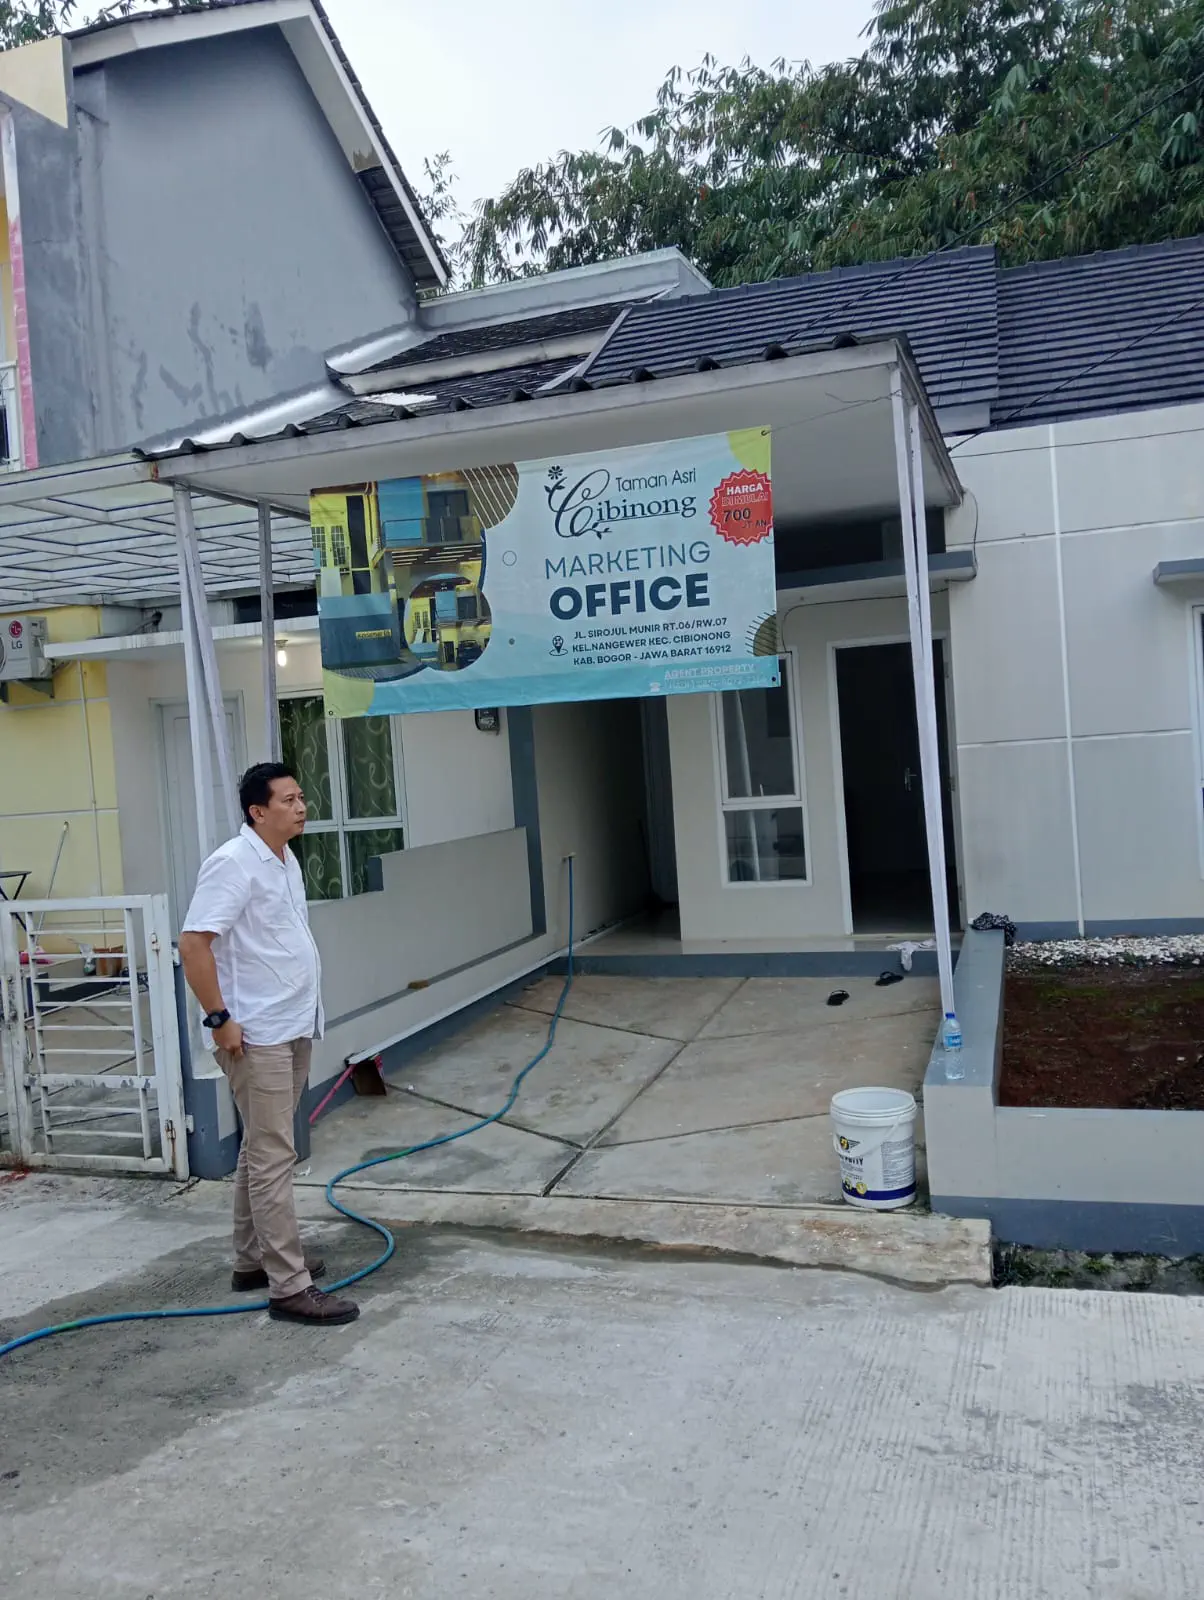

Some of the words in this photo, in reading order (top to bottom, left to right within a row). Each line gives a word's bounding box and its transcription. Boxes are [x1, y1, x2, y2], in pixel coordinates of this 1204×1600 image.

[616, 473, 667, 492] Taman
[672, 468, 696, 483] Asri
[727, 483, 764, 495] HARGA
[546, 468, 697, 538] Cibinong
[723, 508, 751, 522] 700
[545, 541, 710, 579] MARKETING
[549, 572, 710, 620] OFFICE
[574, 631, 586, 639] JL.
[588, 628, 627, 638] SIROJUL
[629, 624, 661, 634] MUNIR
[663, 617, 728, 631] RT.06/RW.07
[648, 635, 671, 646] KEC.
[673, 631, 731, 644] CIBIONONG
[11, 640, 23, 649] LG
[573, 656, 595, 666] KAB.
[597, 653, 632, 664] BOGOR
[640, 650, 668, 660] JAWA
[671, 647, 702, 657] BARAT
[704, 644, 732, 655] 16912
